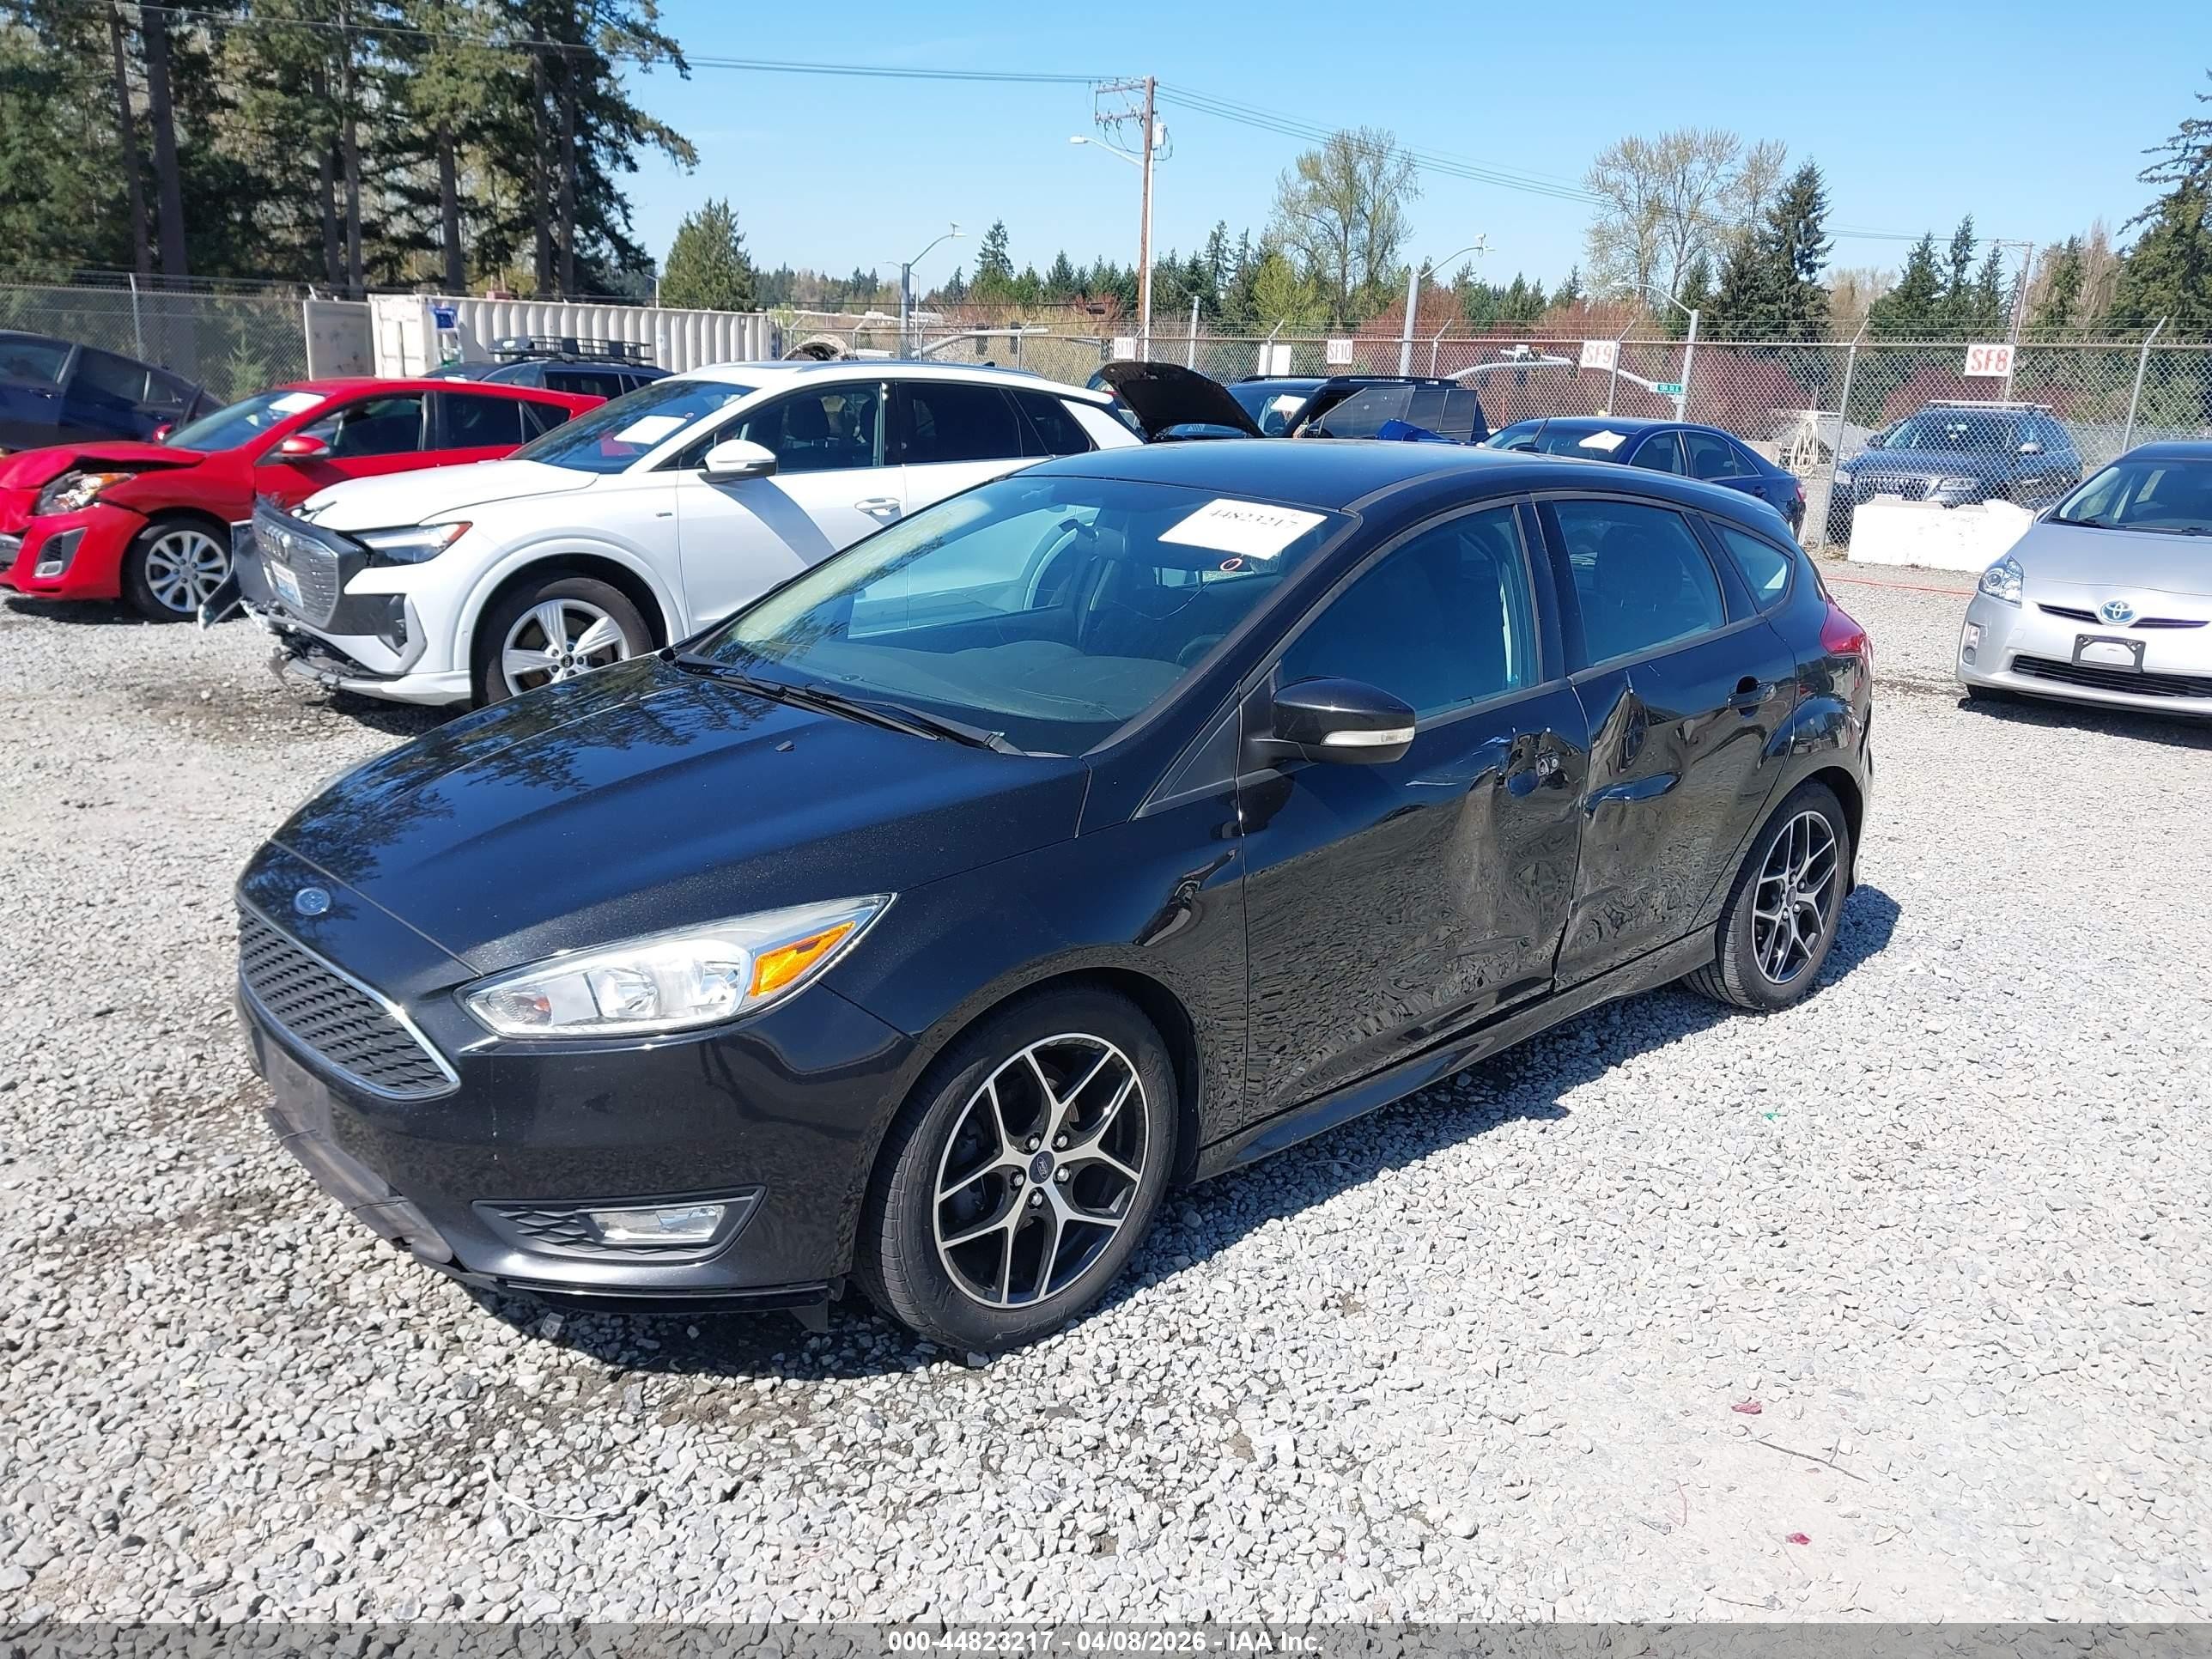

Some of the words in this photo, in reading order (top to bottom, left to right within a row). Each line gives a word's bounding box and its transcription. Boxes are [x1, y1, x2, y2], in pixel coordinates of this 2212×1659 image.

[1115, 340, 1132, 356] SF11
[1328, 343, 1352, 360] SF10
[1585, 344, 1613, 363] SF9
[1971, 349, 2008, 372] SF8
